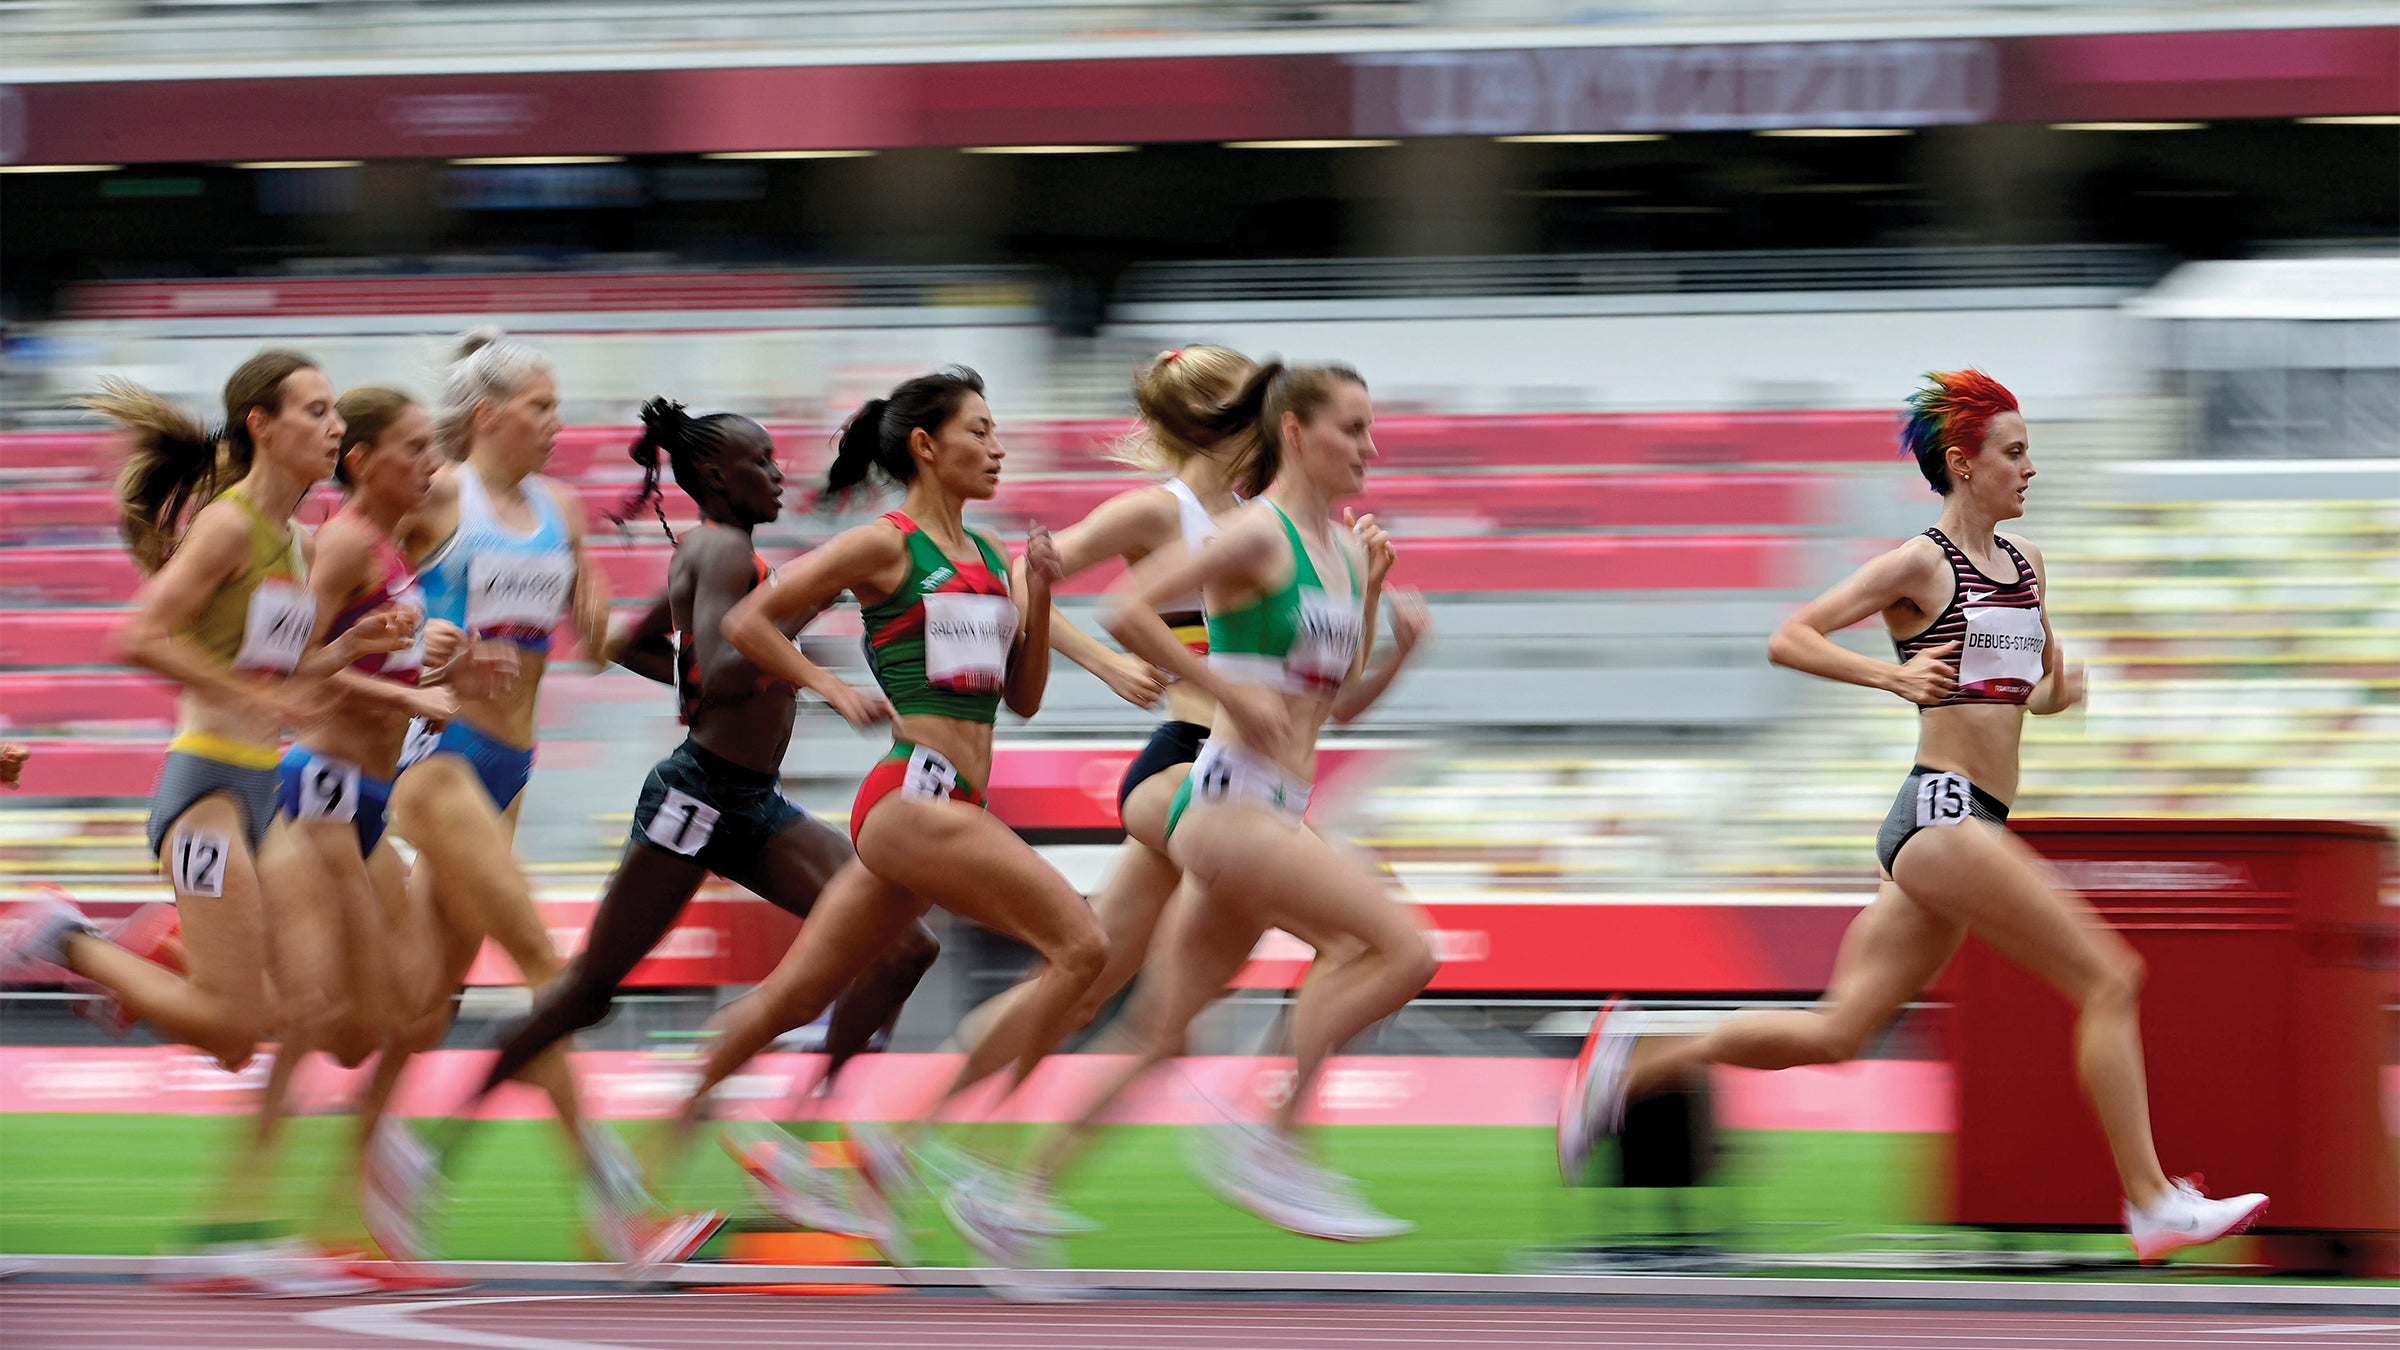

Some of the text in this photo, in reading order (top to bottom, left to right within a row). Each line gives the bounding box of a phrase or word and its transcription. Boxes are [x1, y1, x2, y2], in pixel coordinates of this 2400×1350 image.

[314, 766, 345, 816] 9
[1926, 777, 1964, 820] 15
[673, 803, 700, 848] 1
[178, 833, 219, 893] 12
